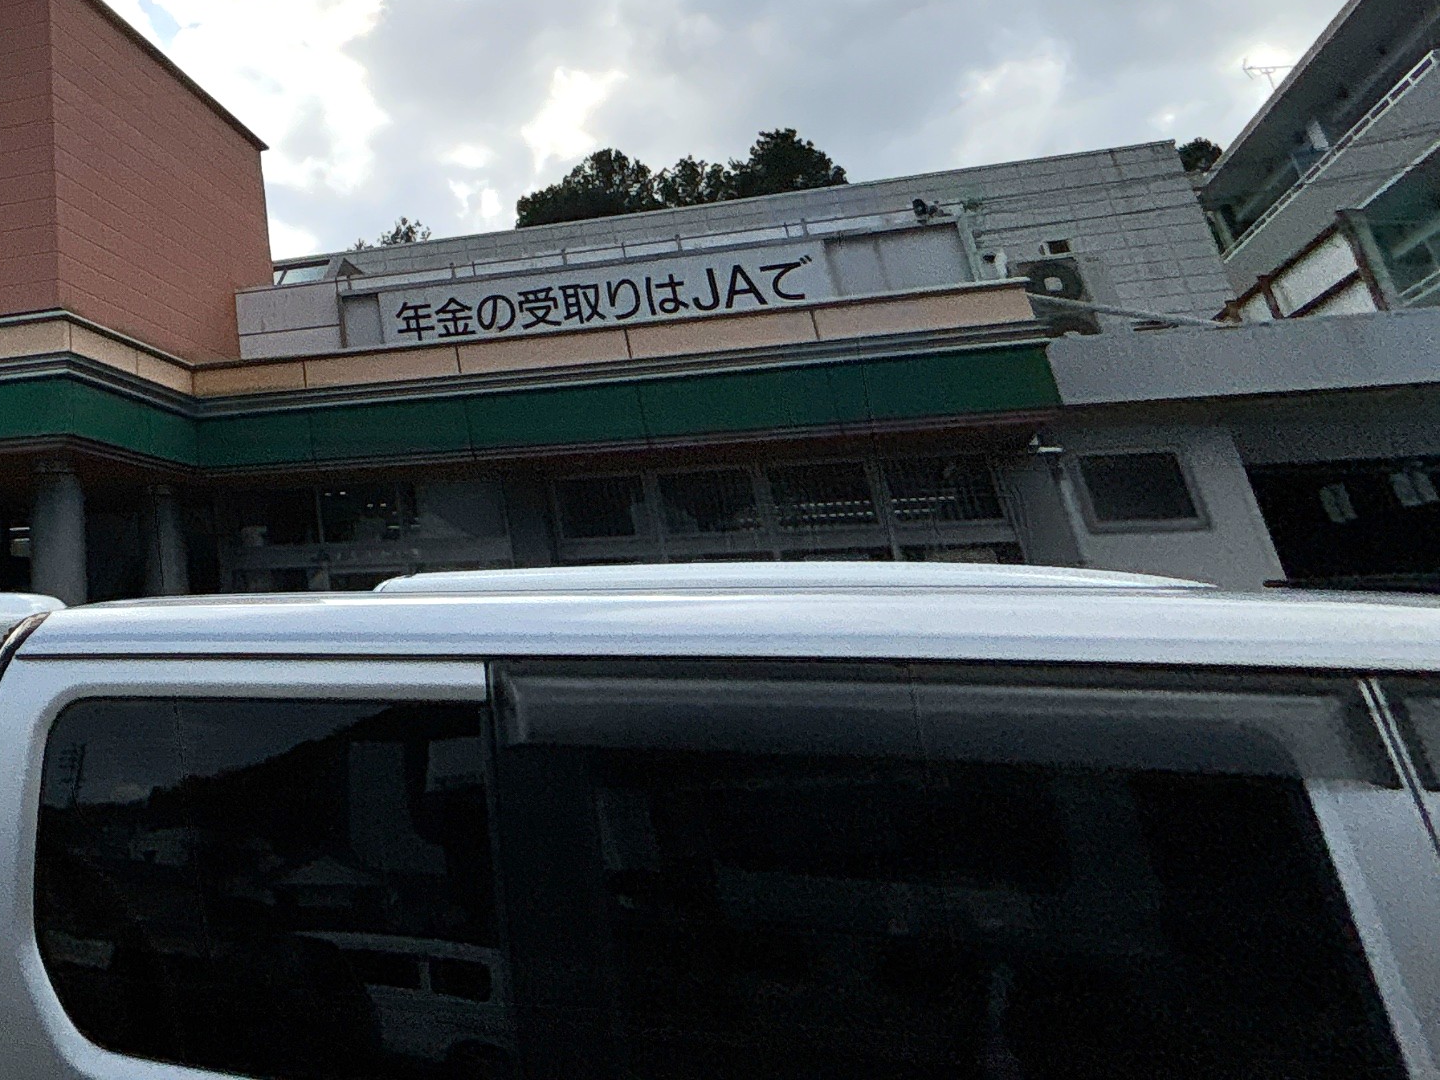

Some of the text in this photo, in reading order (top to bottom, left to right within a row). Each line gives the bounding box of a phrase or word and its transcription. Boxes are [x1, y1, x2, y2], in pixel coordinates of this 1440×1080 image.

[396, 255, 812, 341] 年金の受取りはJAで
